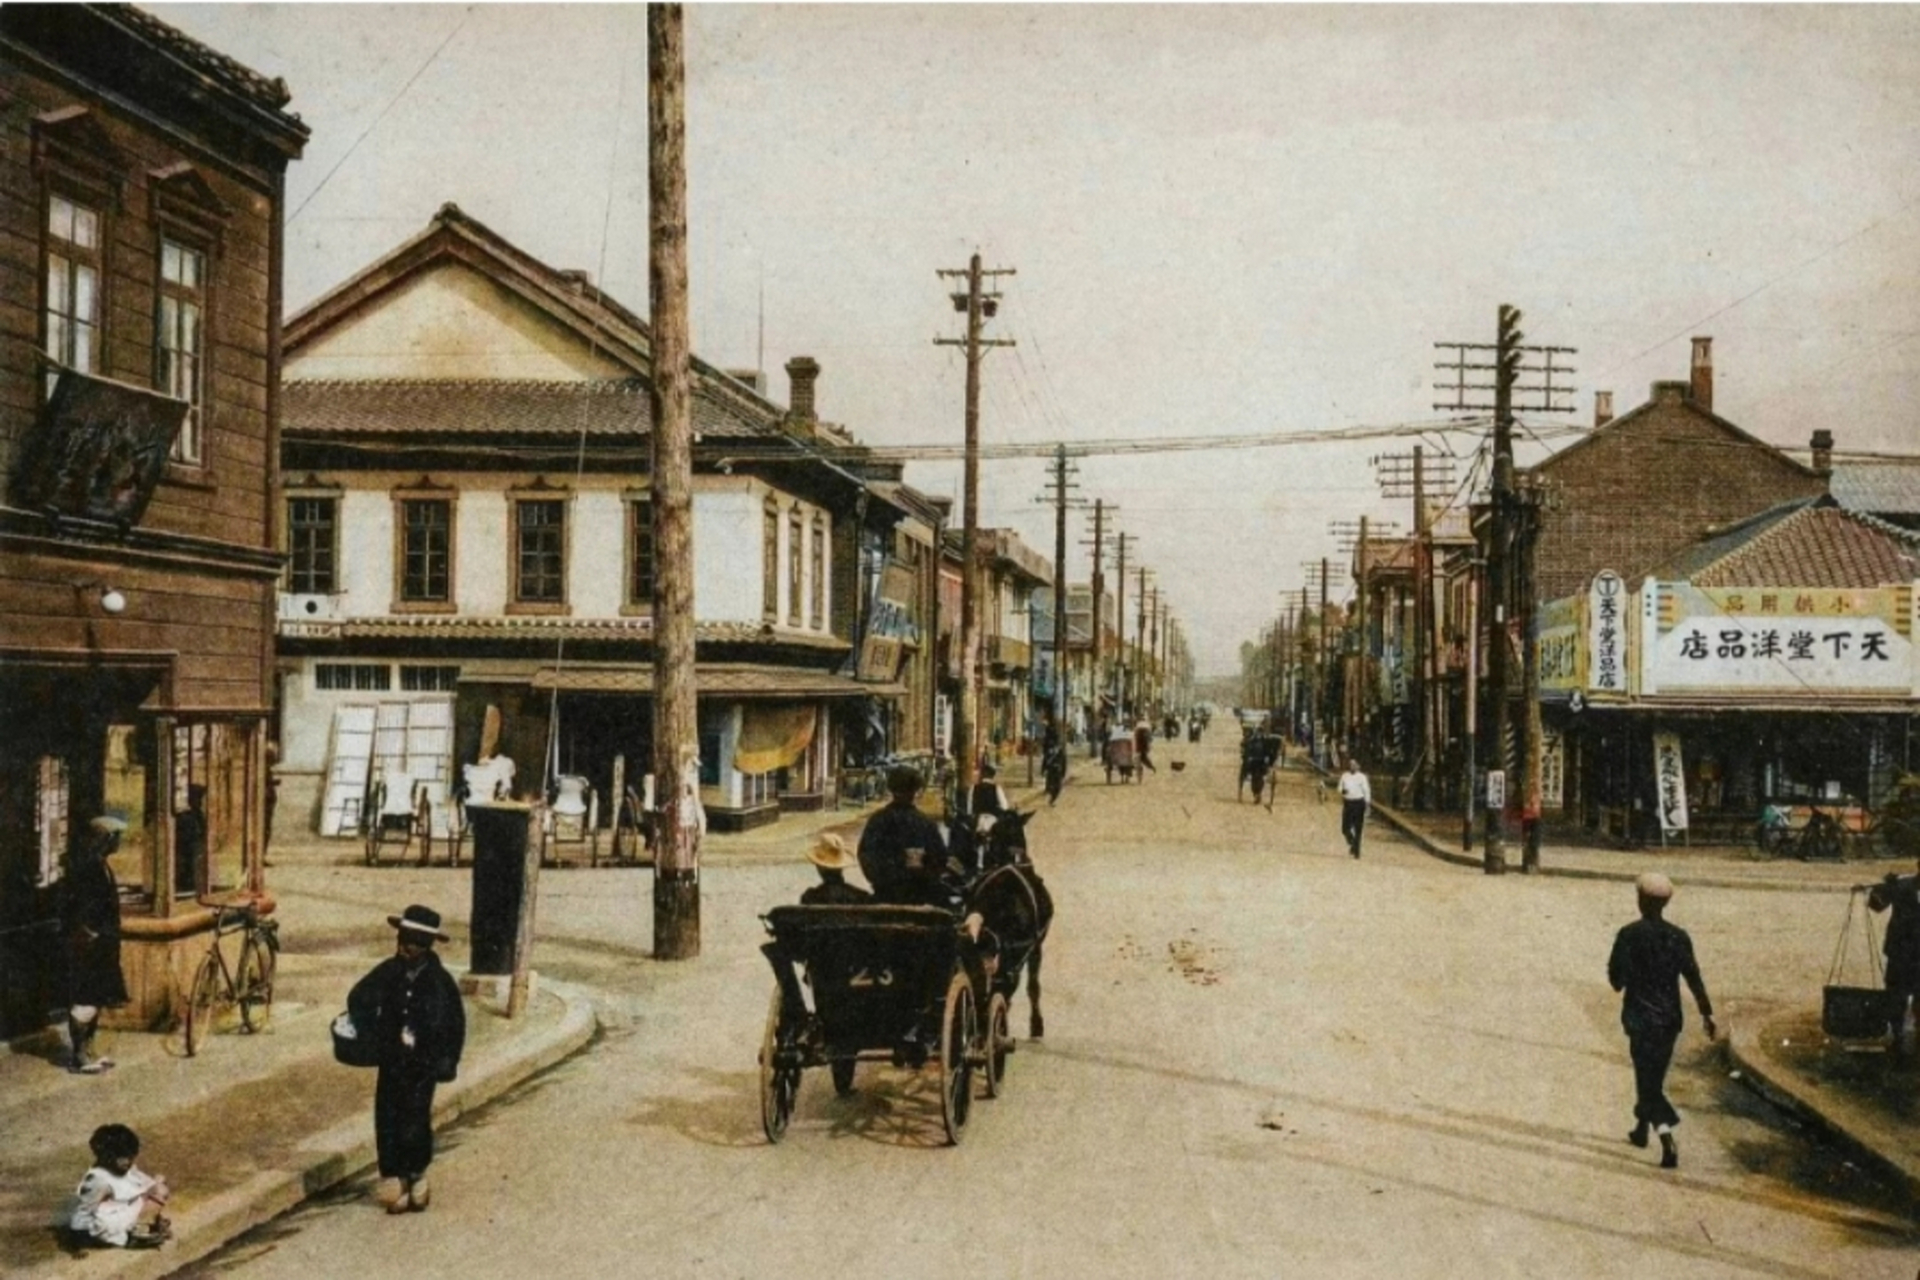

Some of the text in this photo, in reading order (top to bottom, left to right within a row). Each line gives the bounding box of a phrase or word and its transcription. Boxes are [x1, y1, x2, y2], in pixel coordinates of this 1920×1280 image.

[1598, 597, 1616, 688] 天下堂洋品店
[1680, 629, 1889, 661] 天下堂洋品店
